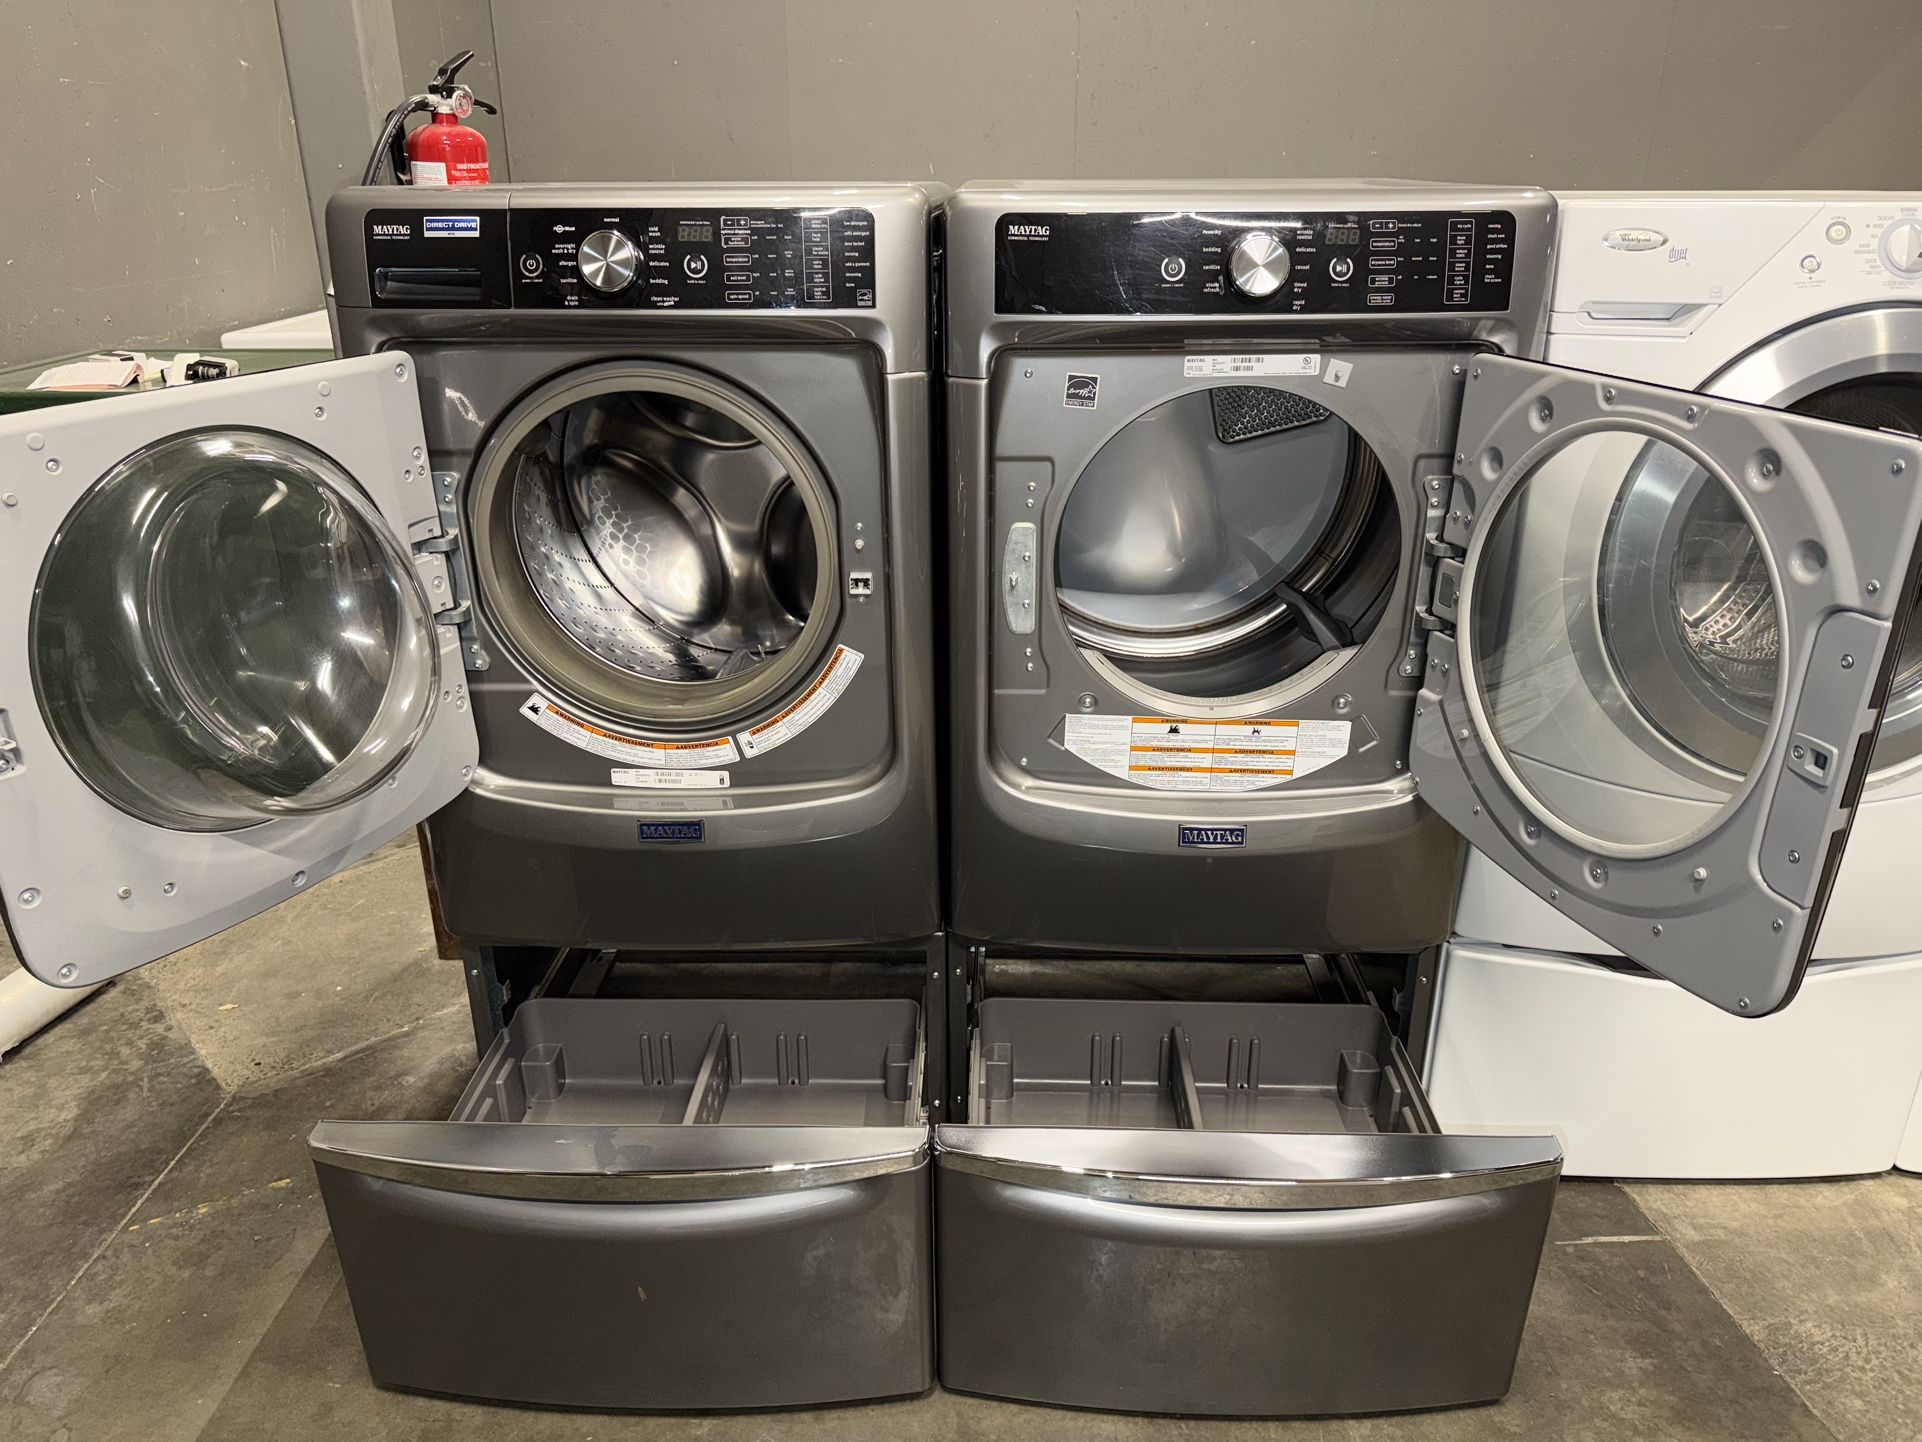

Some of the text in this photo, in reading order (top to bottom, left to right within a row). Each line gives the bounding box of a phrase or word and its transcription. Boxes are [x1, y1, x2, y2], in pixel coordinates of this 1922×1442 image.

[372, 225, 411, 235] MAYTAG
[1008, 225, 1050, 236] MAYTAG
[1622, 236, 1652, 244] Whirlpool
[1668, 246, 1688, 262] duet
[784, 685, 818, 718] AVERTISSEMENT
[558, 711, 584, 728] WARNING
[756, 718, 779, 734] WARNING
[607, 732, 654, 748] AVERTISSEMENT
[680, 741, 720, 749] ADVERTENCIA
[642, 826, 700, 837] MAYTAG
[1184, 830, 1242, 843] MAYTAG
